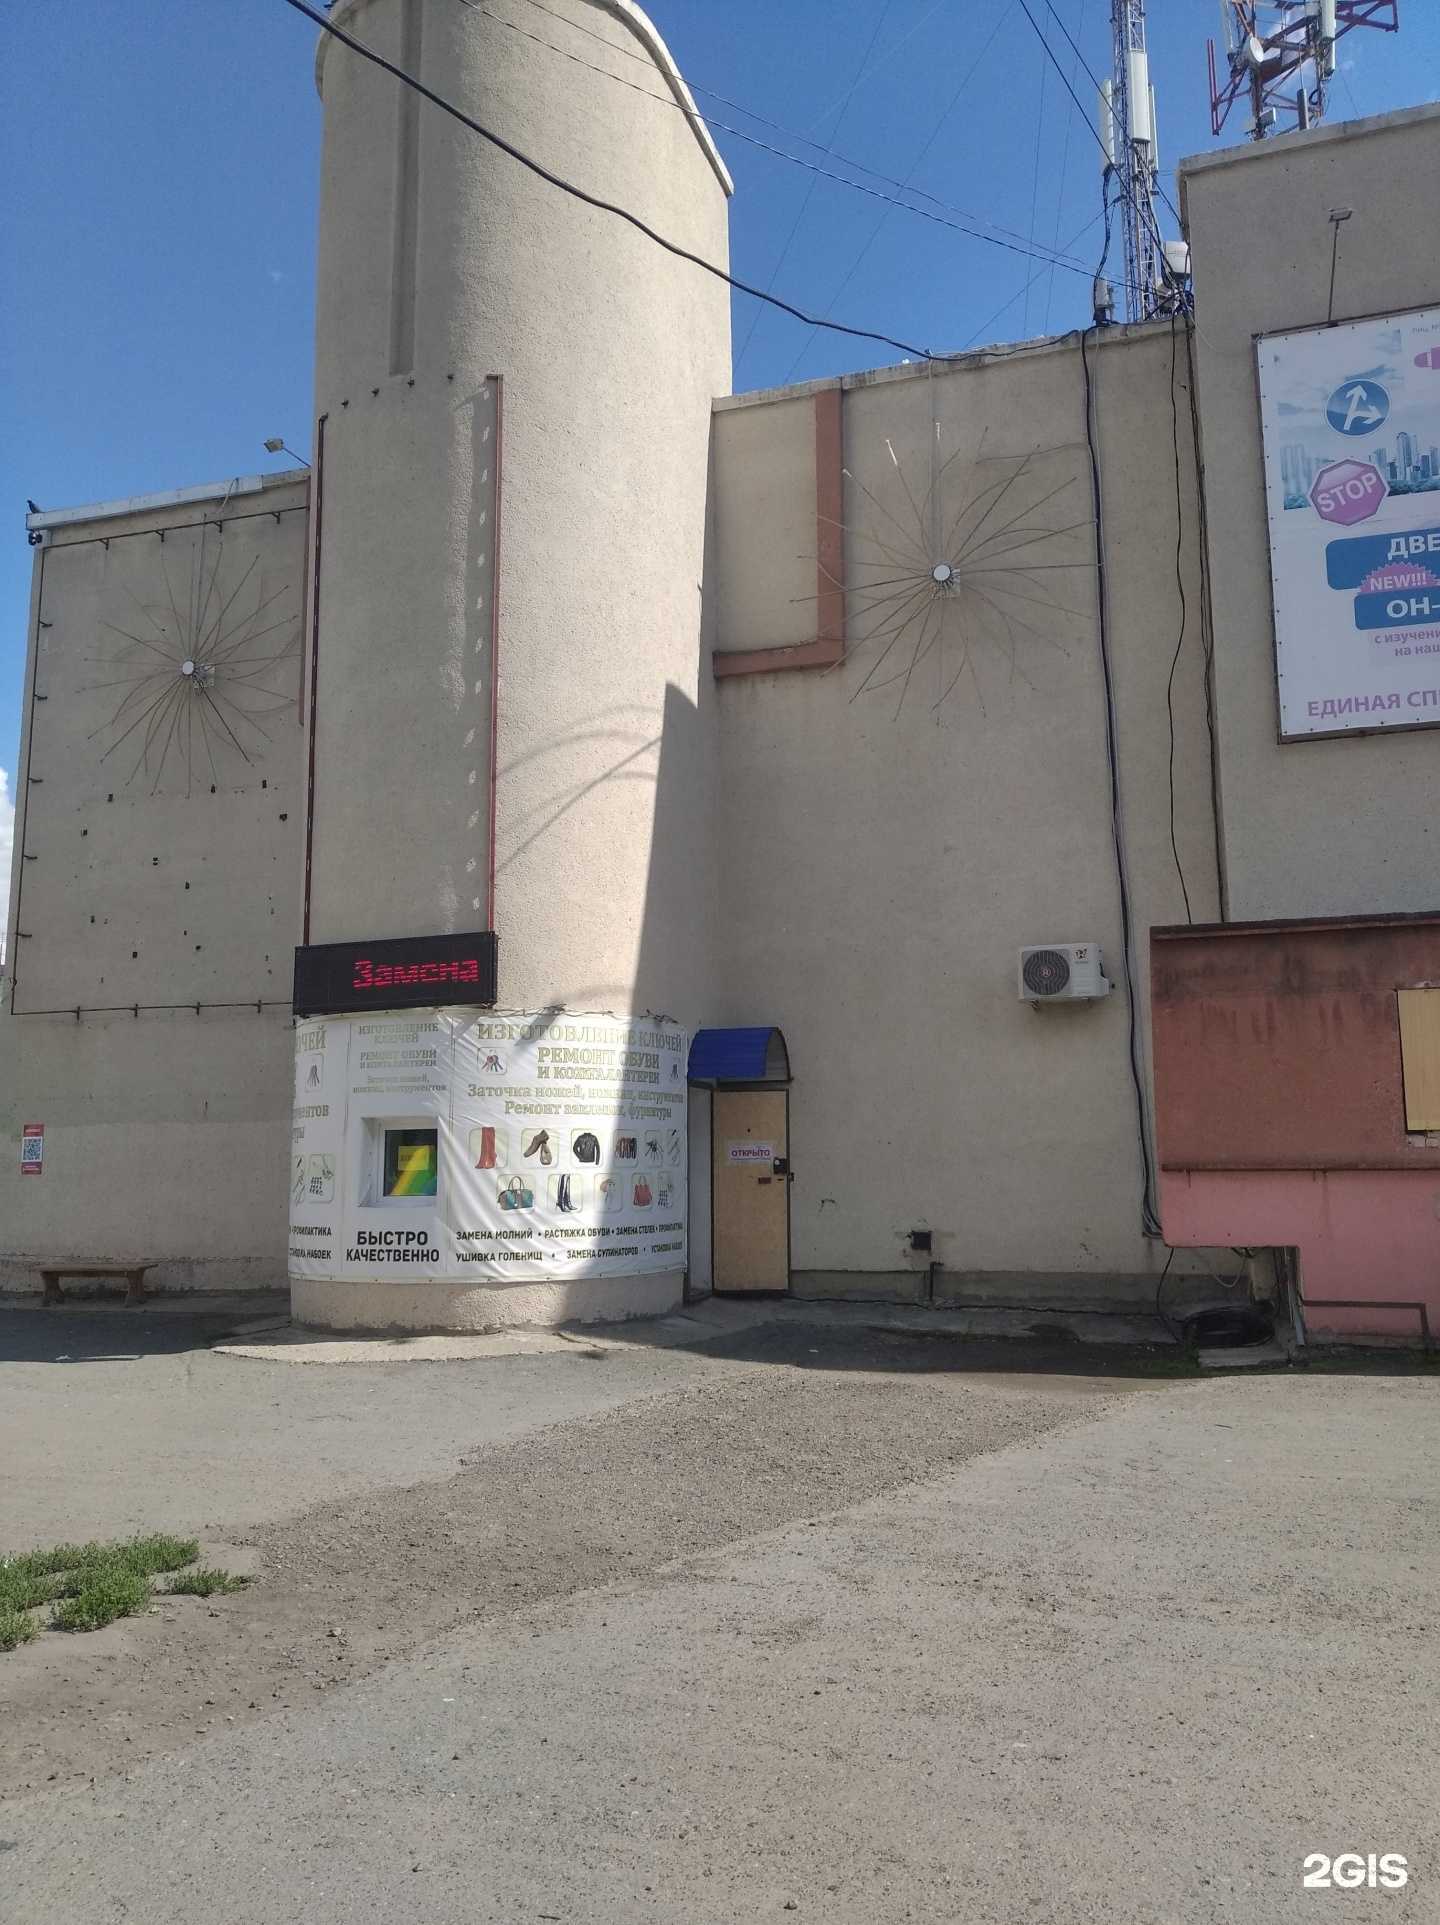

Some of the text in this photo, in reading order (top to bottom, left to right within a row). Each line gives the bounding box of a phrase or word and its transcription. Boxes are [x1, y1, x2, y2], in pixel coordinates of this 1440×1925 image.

[1317, 472, 1378, 513] STOP
[1370, 572, 1427, 591] NEW!!!
[1395, 647, 1411, 656] на
[1307, 690, 1440, 719] ЕДИНАЯ СП
[537, 1047, 617, 1065] РЕМОНТ
[537, 1066, 549, 1079] И
[468, 1083, 532, 1098] Заточка
[505, 1101, 562, 1115] Ремонт
[731, 1148, 770, 1158] ОТКРЫТО
[357, 1231, 428, 1246] БЫСТРО
[456, 1230, 493, 1240] ЗАМЕНА
[496, 1227, 533, 1240] МОЛНИЙ
[544, 1228, 586, 1239] РАСТЯЖКА
[587, 1226, 610, 1238] ОБУВИ
[615, 1224, 639, 1236] ЗАМЕНА
[346, 1249, 440, 1262] КАЧЕСТВЕННО
[456, 1252, 496, 1262] УШИВКА
[499, 1251, 543, 1262] ГОЛЕНИЩ
[566, 1249, 596, 1260] ЗАМЕНА
[597, 1246, 639, 1258] СУПИНАТОРОВ
